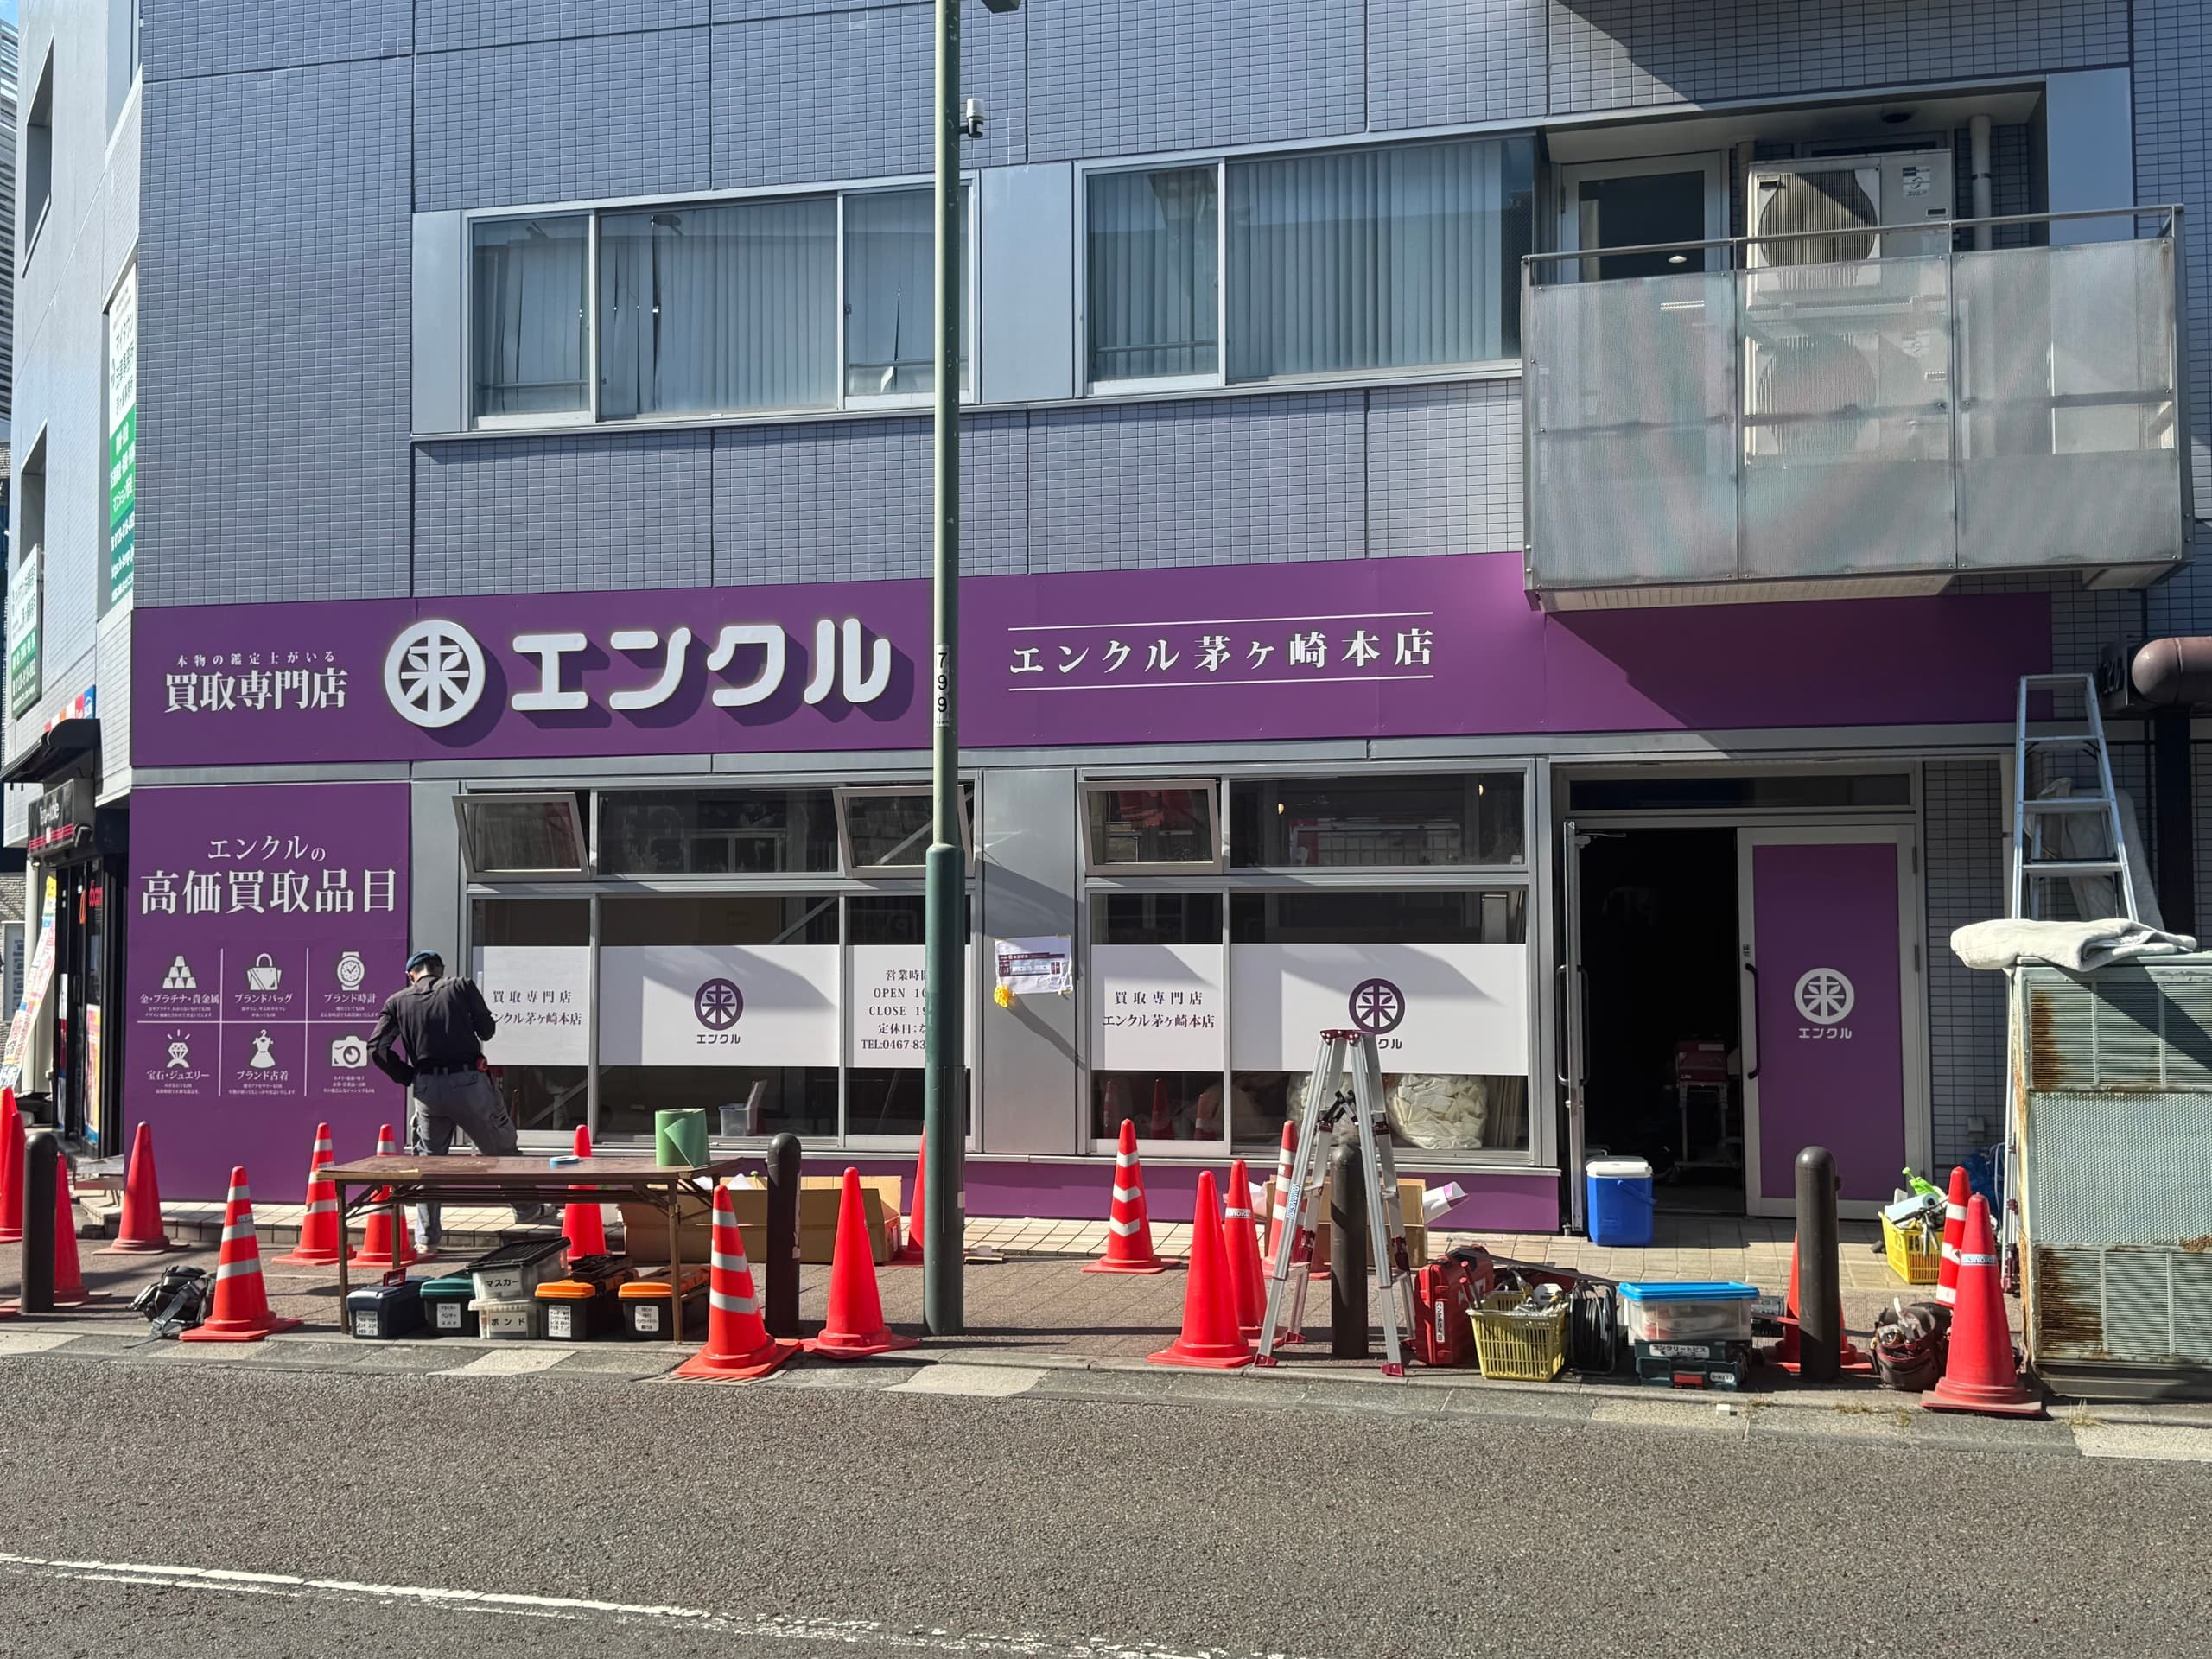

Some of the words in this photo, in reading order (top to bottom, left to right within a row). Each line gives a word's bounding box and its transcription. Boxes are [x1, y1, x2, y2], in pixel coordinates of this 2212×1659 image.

[1008, 627, 1434, 675] エンクル茅ヶ崎本店
[176, 650, 335, 668] 本物の鑑定士がいる
[511, 618, 892, 711] エンクル
[938, 652, 948, 713] 799
[163, 667, 348, 714] 買取専門店
[207, 834, 327, 862] エンクルの
[140, 868, 397, 915] 高価買取品目
[234, 993, 294, 1004] ブランドバッグ
[324, 992, 377, 1004] ブランド時計
[493, 990, 572, 1004] 買取専門店
[874, 988, 906, 999] OPEN
[1115, 990, 1203, 1006] 買取専門店
[868, 1006, 906, 1016] CLOSE
[493, 1012, 582, 1026] ンクル茅ヶ崎本店
[1103, 1013, 1216, 1029] エンクル茅ヶ崎本店
[696, 1033, 741, 1045] エンクル
[1798, 1027, 1853, 1039] エンクル
[1378, 1038, 1402, 1050] クル
[236, 1070, 289, 1082] ブランド古着
[486, 1278, 520, 1288] マスカー
